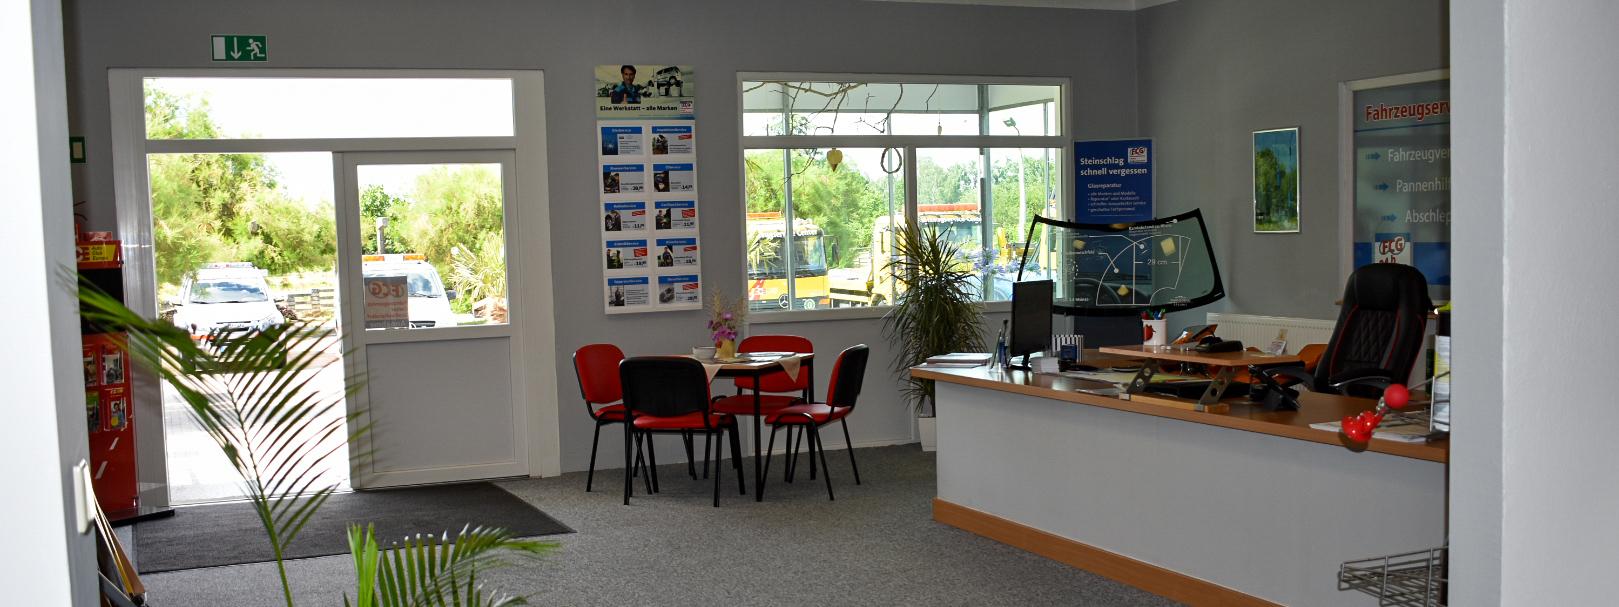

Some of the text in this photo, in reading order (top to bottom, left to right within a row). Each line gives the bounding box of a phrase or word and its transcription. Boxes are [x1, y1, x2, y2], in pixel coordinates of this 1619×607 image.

[1080, 156, 1125, 166] Steinschlag
[1080, 167, 1148, 177] schnell vergessen
